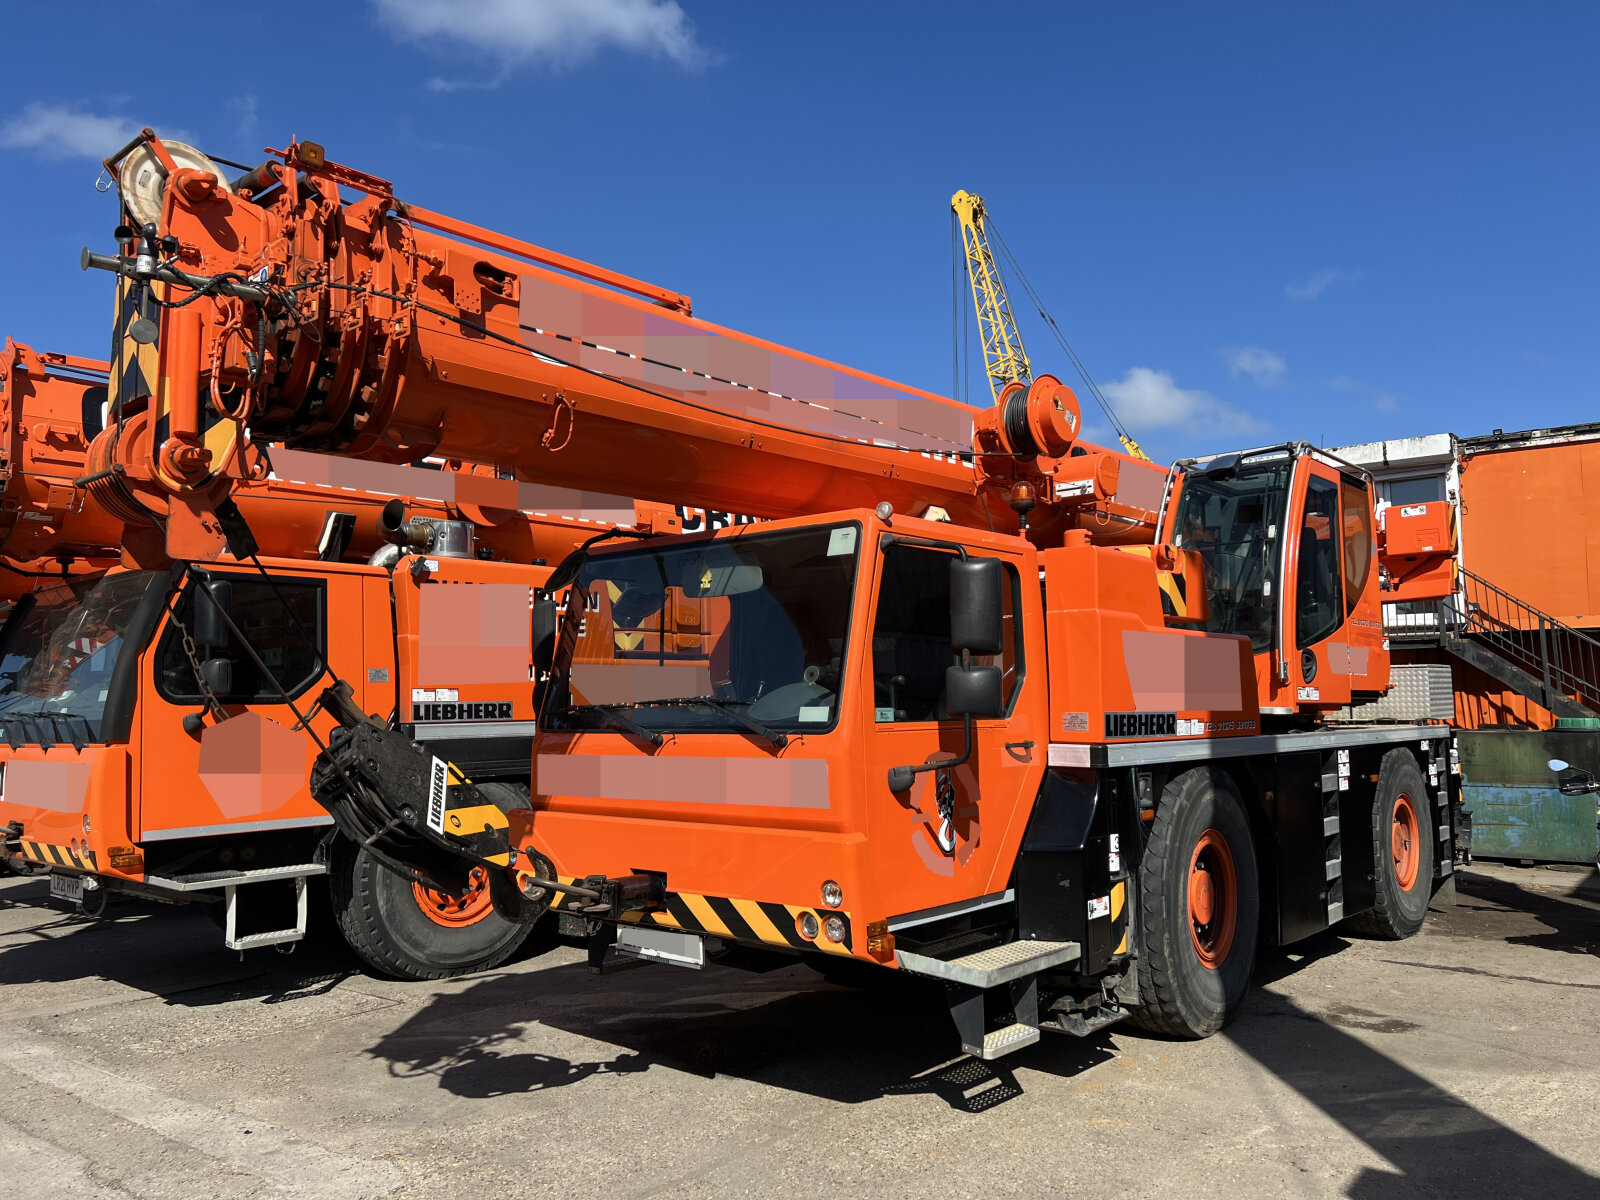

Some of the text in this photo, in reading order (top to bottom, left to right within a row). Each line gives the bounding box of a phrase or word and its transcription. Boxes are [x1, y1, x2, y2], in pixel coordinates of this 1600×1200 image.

[413, 703, 512, 721] LIEBHERR
[1105, 714, 1176, 737] LIEBHERR
[430, 763, 445, 827] LIEBHERR
